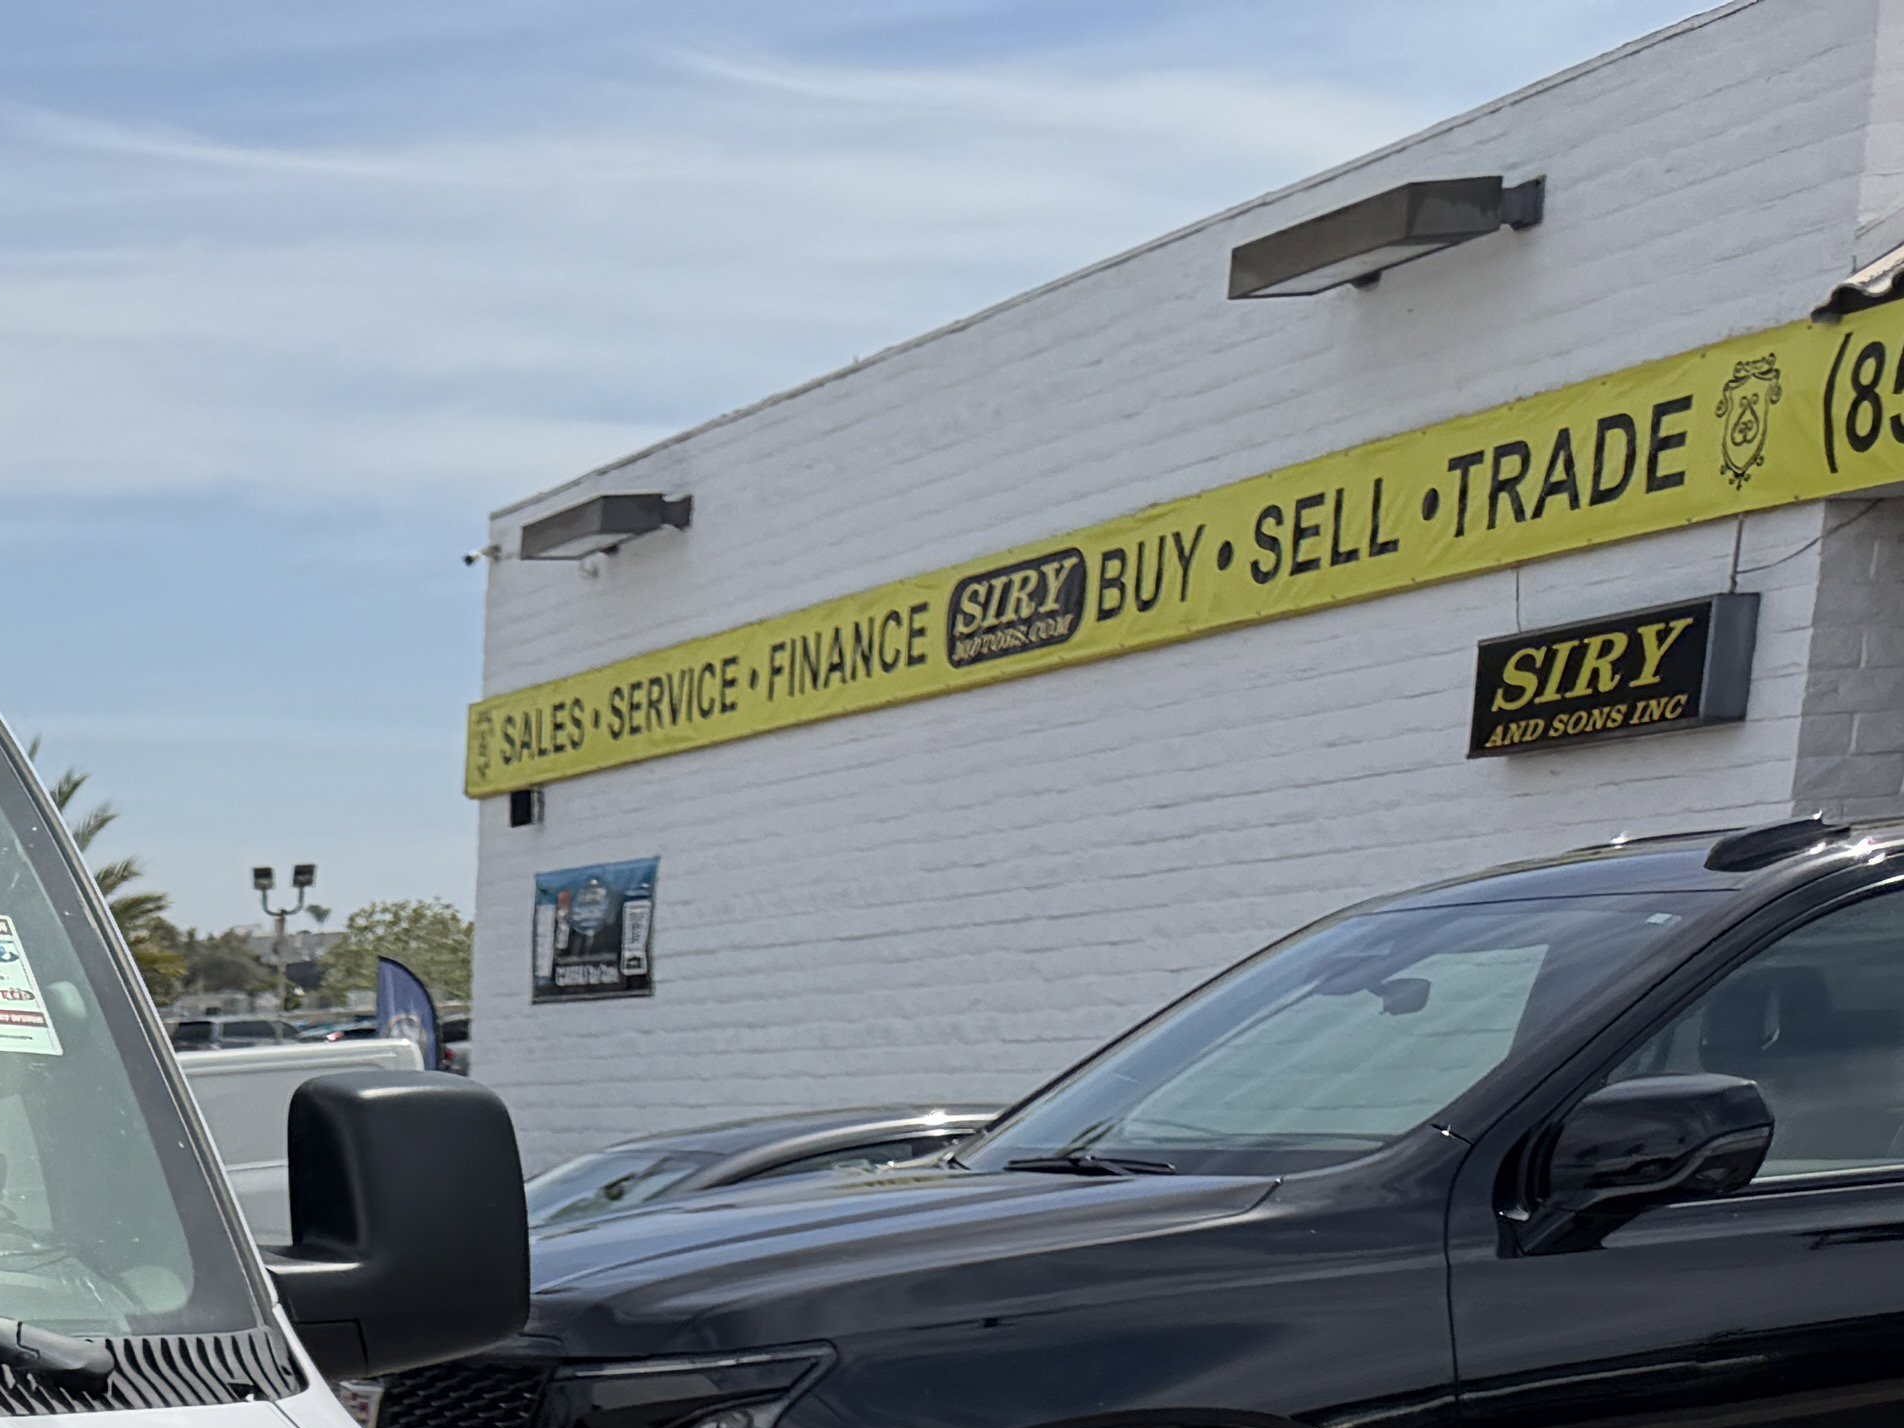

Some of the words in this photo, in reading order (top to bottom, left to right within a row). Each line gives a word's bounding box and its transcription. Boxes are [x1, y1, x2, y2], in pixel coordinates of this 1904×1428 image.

[1096, 524, 1207, 623] BUY
[1250, 477, 1400, 585] SELL
[1446, 394, 1694, 538] TRADE
[953, 556, 1080, 637] SIRY
[501, 696, 585, 765] SALES
[607, 655, 740, 740] SERVICE
[767, 601, 930, 701] FINANCE
[1491, 617, 1694, 712] SIRY
[1485, 718, 1545, 748] AND
[1548, 703, 1628, 738] SONS
[1629, 693, 1689, 725] INC
